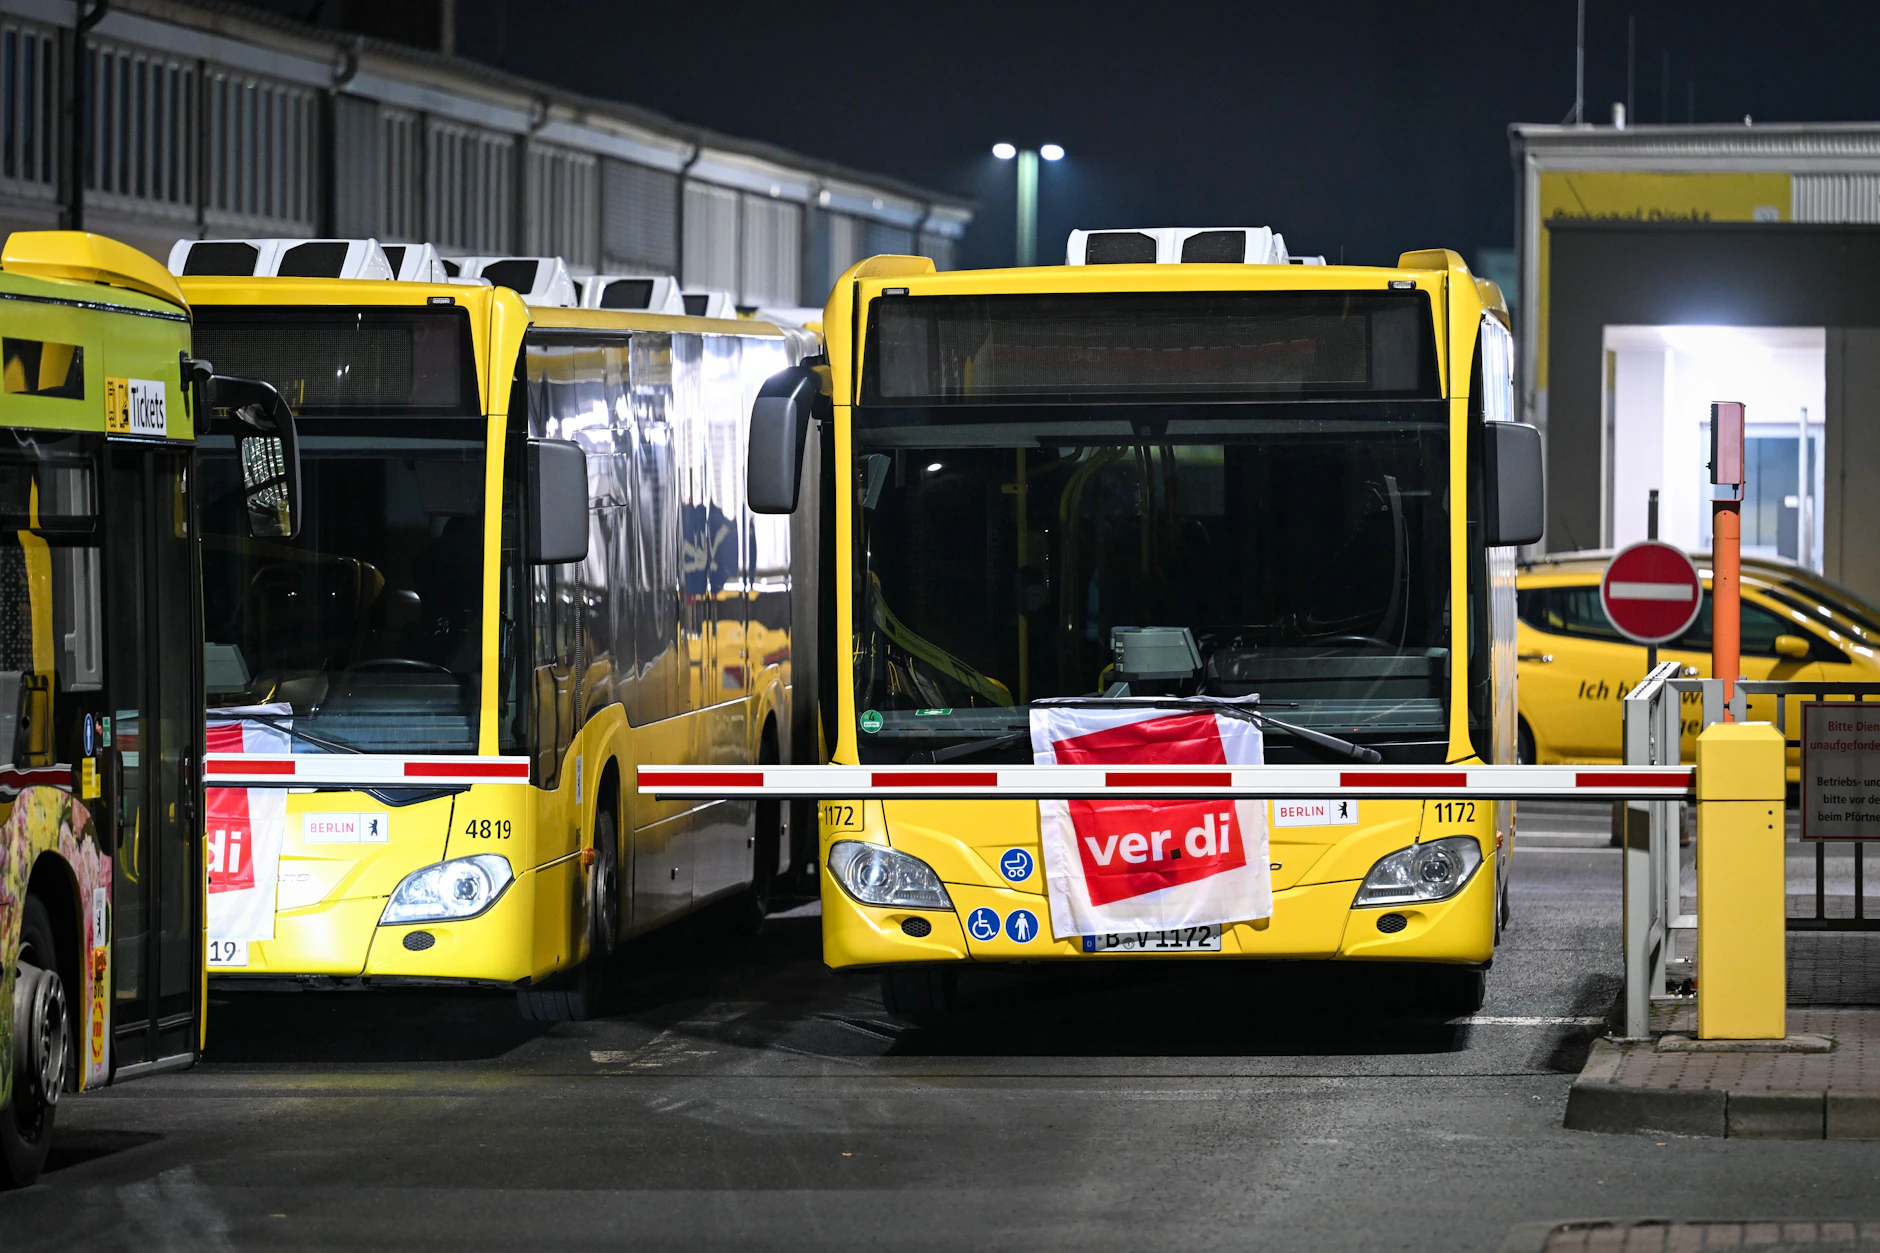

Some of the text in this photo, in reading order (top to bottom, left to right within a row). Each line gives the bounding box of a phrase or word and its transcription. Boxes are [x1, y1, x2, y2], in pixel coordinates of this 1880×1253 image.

[131, 385, 164, 429] Tickets
[1578, 680, 1609, 699] Ich
[868, 711, 876, 721] 4
[1828, 721, 1880, 731] Bitte Dien
[1810, 739, 1880, 752] unaufgeforde
[1817, 777, 1861, 787] Betriebs-
[1823, 794, 1846, 804] bitte
[1868, 794, 1880, 804] de
[824, 806, 854, 826] 1172
[1280, 806, 1324, 817] BERLIN
[1434, 802, 1475, 823] 1172
[1818, 811, 1880, 822] beim Pförtne
[310, 823, 354, 833] BERLIN
[465, 820, 511, 839] 4819
[1084, 813, 1230, 867] ver.di
[1106, 925, 1211, 948] B V 1172
[209, 941, 237, 962] 19
